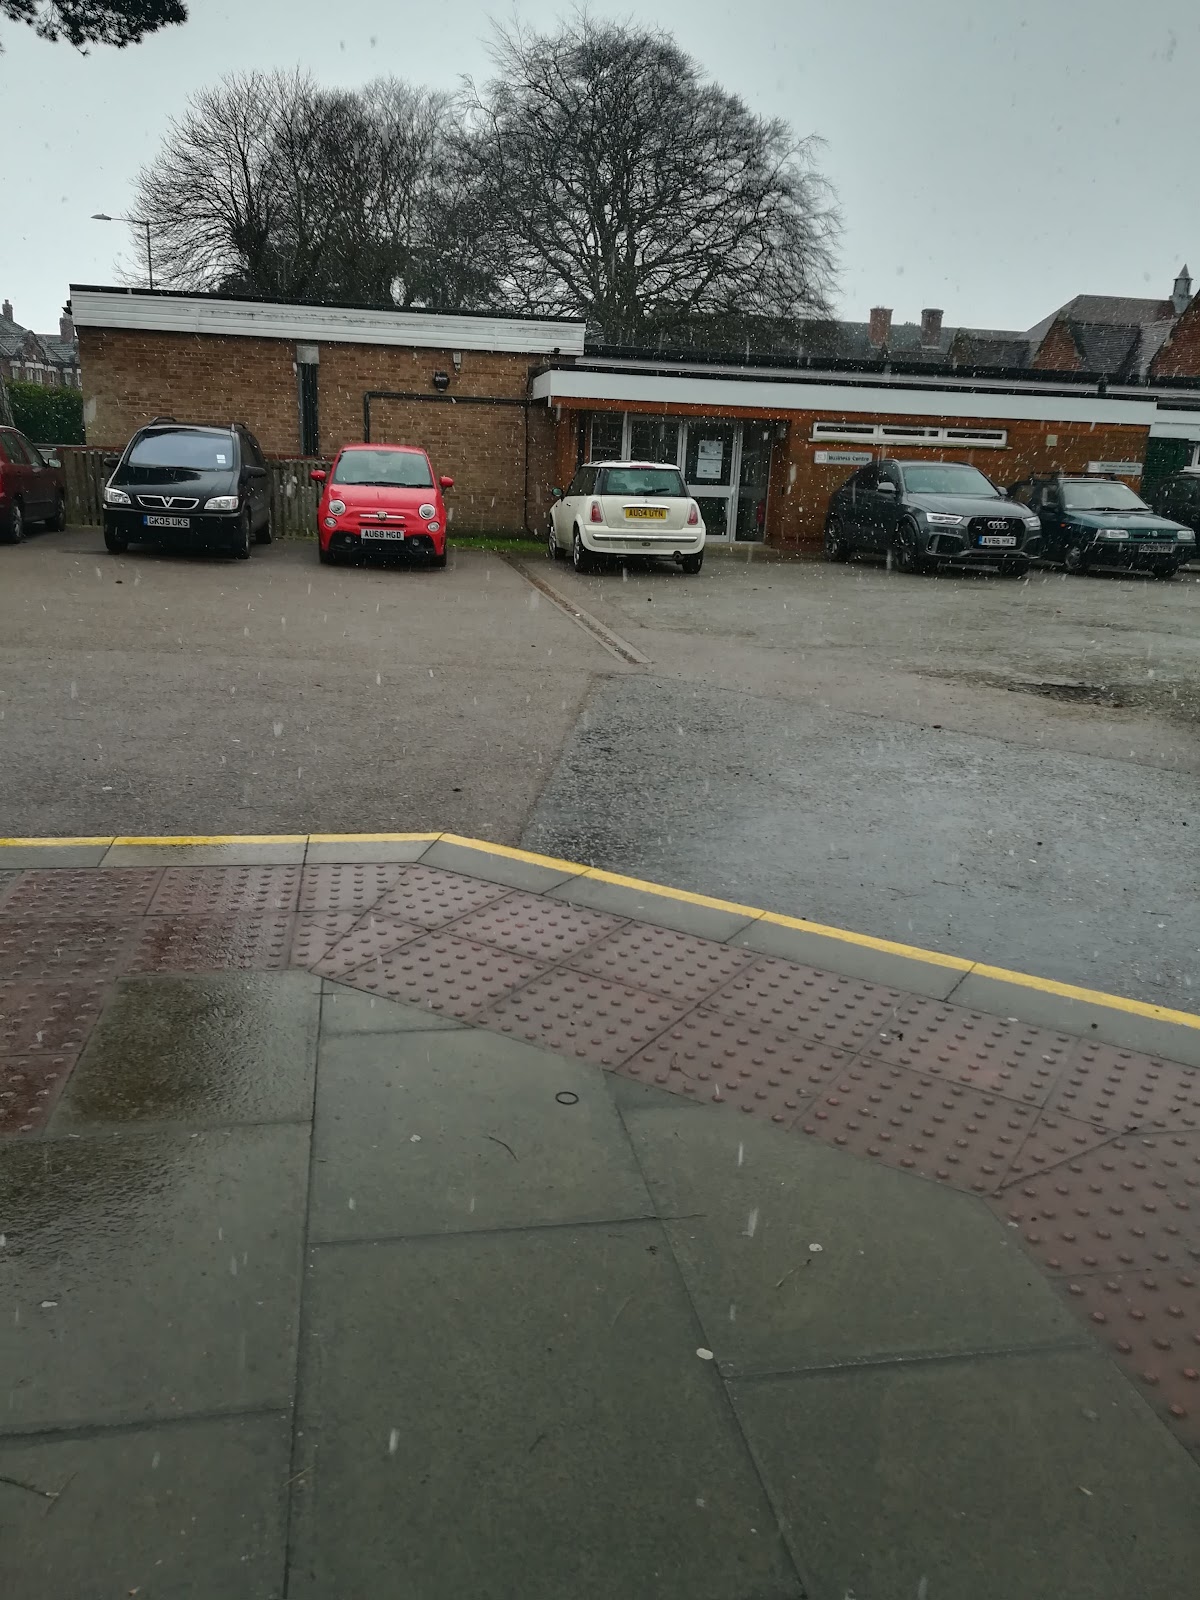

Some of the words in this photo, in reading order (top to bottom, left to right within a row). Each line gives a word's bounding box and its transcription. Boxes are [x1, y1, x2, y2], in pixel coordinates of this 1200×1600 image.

[149, 516, 170, 526] GK05
[172, 518, 189, 527] UKS
[364, 530, 385, 538] AU68
[386, 531, 402, 539] HGD
